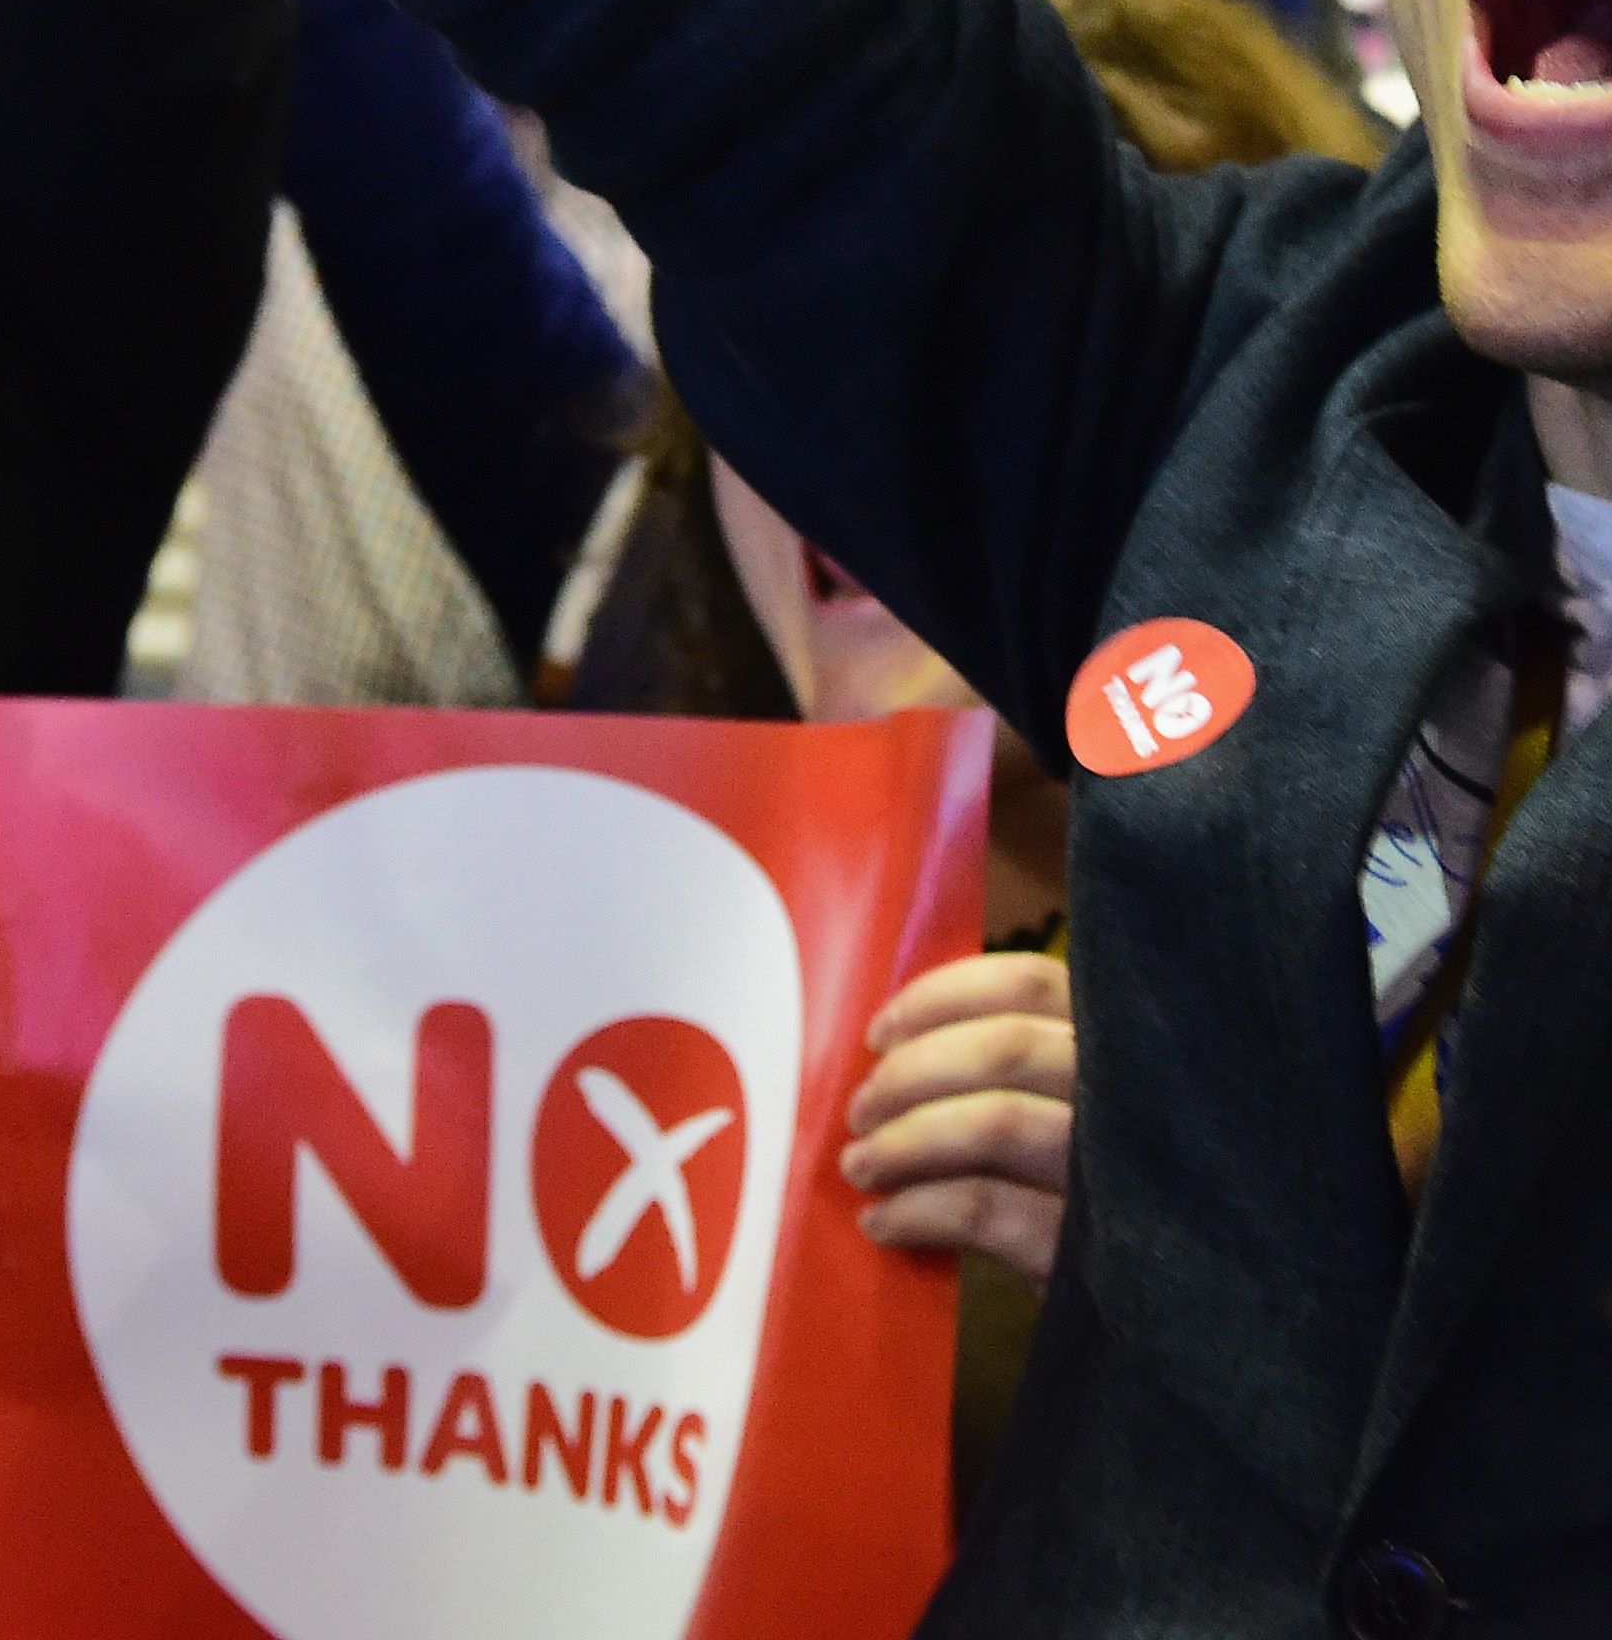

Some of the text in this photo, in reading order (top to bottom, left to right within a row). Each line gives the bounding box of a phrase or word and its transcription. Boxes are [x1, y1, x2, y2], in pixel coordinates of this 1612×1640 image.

[1127, 643, 1213, 739] NO
[215, 992, 748, 1342] NO
[216, 1354, 709, 1530] THANKS
